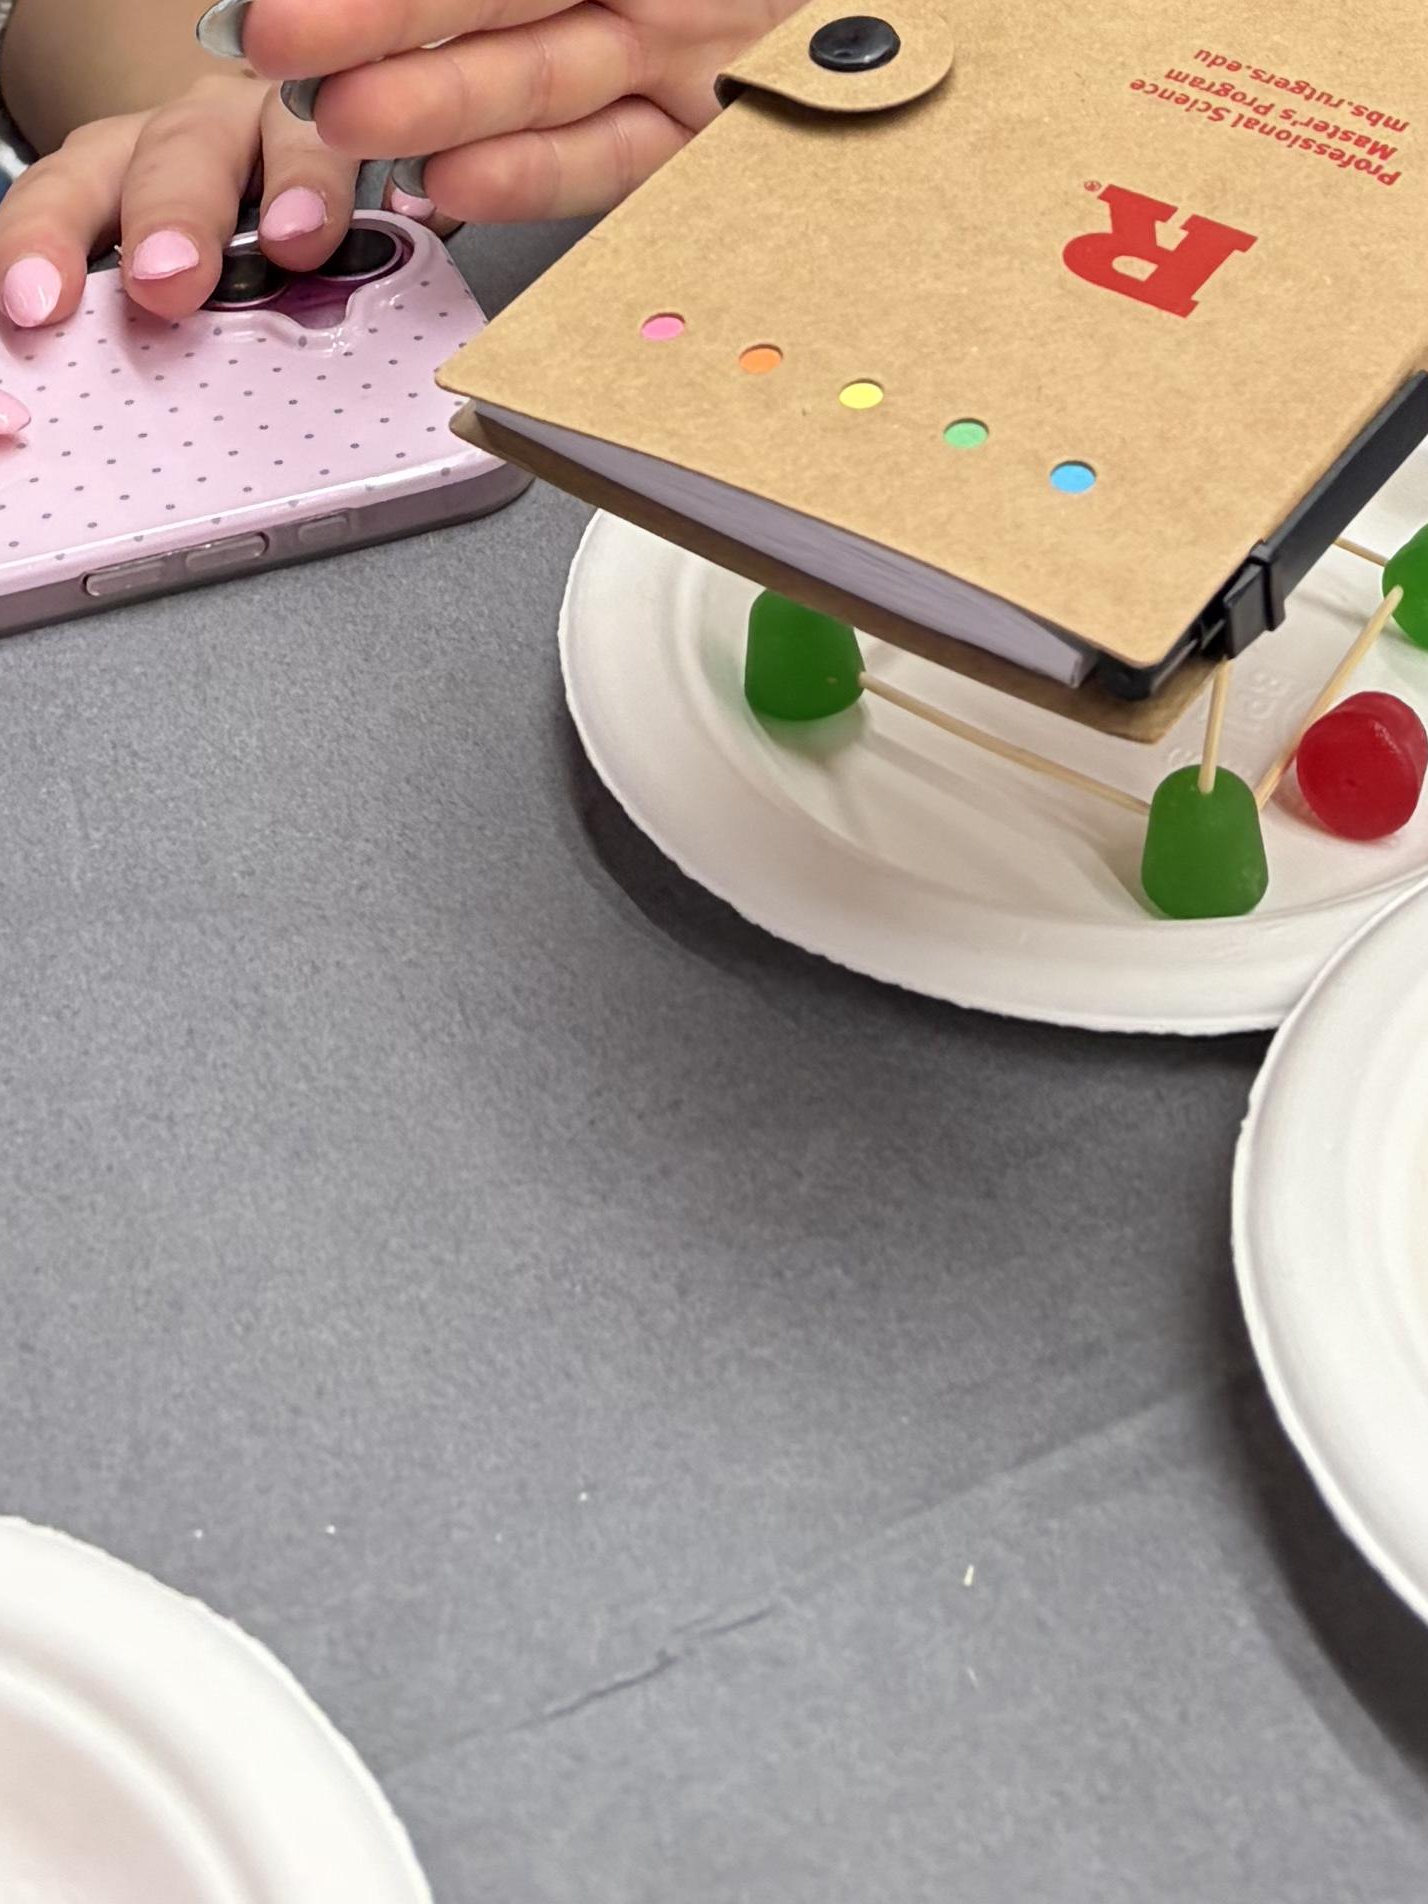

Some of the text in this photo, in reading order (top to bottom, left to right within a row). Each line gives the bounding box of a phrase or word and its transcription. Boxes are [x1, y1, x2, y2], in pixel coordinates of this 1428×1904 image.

[1129, 78, 1402, 186] Professional Science
[1164, 68, 1399, 161] Master's Program
[1193, 49, 1410, 133] mbs.rutgers.edu
